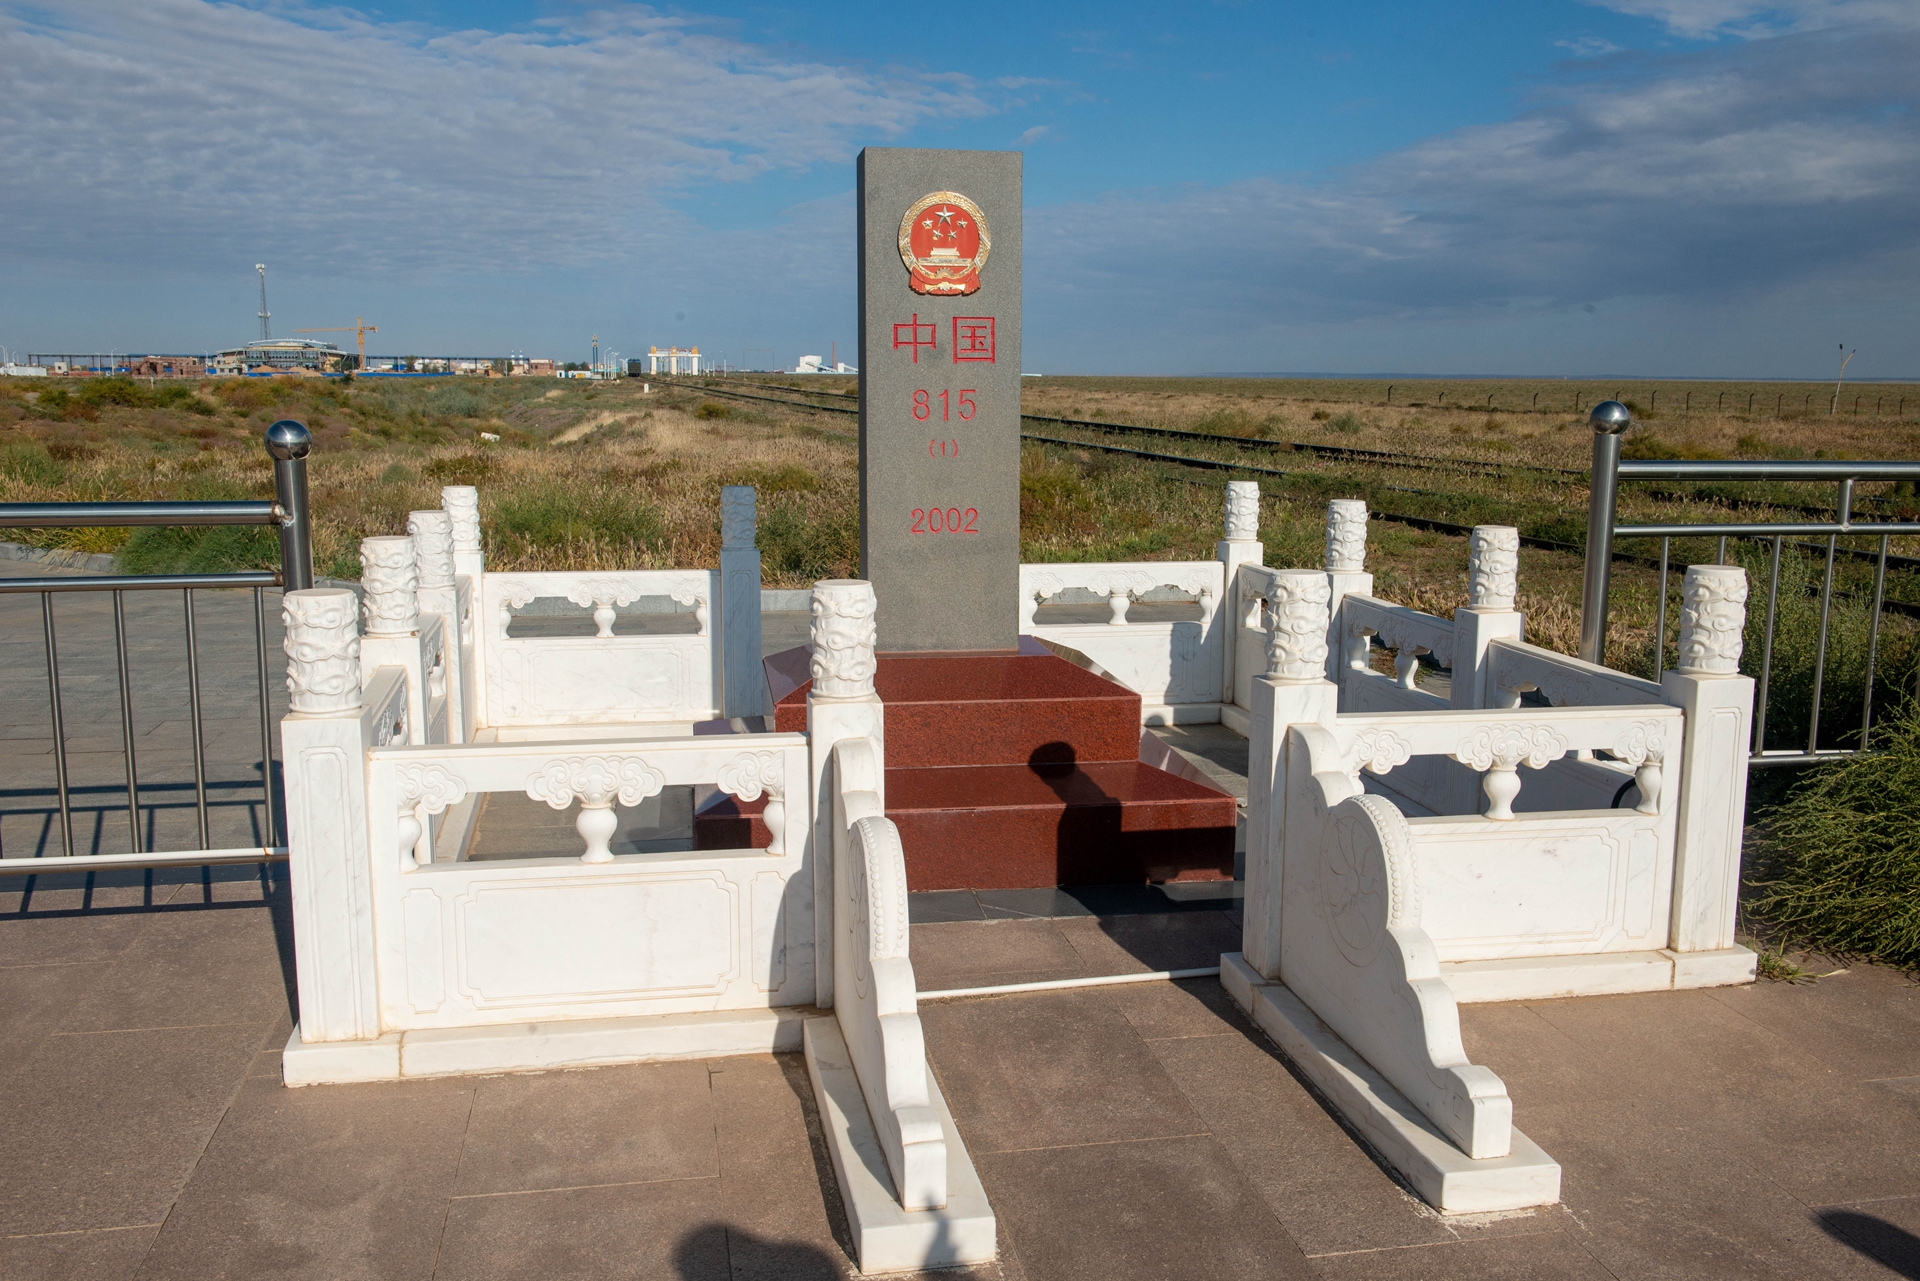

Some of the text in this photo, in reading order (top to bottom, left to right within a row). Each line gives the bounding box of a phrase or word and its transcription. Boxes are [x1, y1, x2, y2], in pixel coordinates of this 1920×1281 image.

[893, 313, 995, 364] 中国
[911, 388, 977, 422] 815
[928, 439, 959, 459] (1)
[910, 507, 979, 534] 2002
